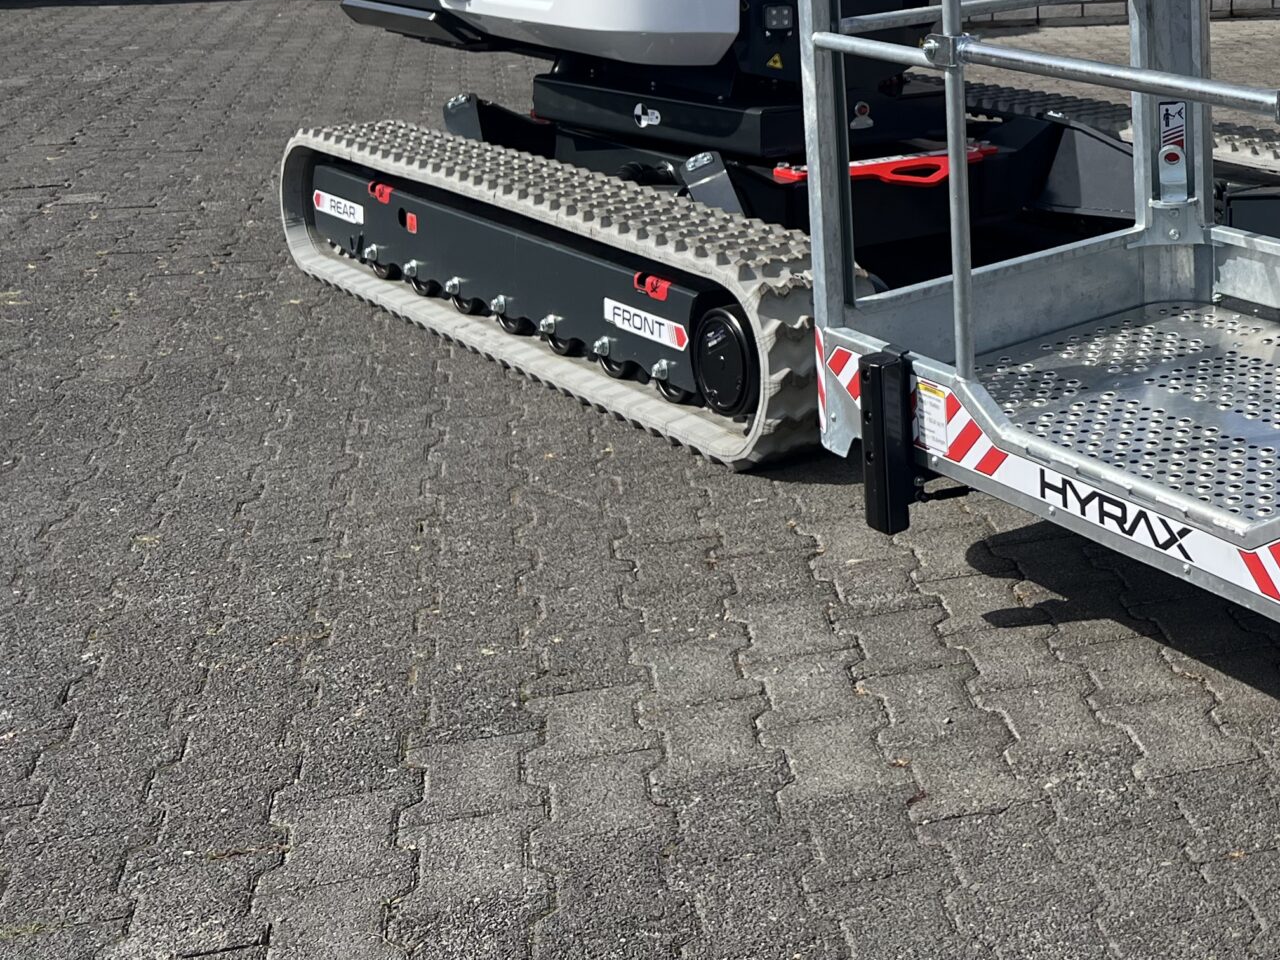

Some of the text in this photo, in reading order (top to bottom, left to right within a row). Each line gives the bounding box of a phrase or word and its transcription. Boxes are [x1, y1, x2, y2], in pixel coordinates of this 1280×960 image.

[329, 199, 356, 220] REAR
[612, 306, 665, 339] FRONT
[1040, 468, 1195, 563] HYRAX
